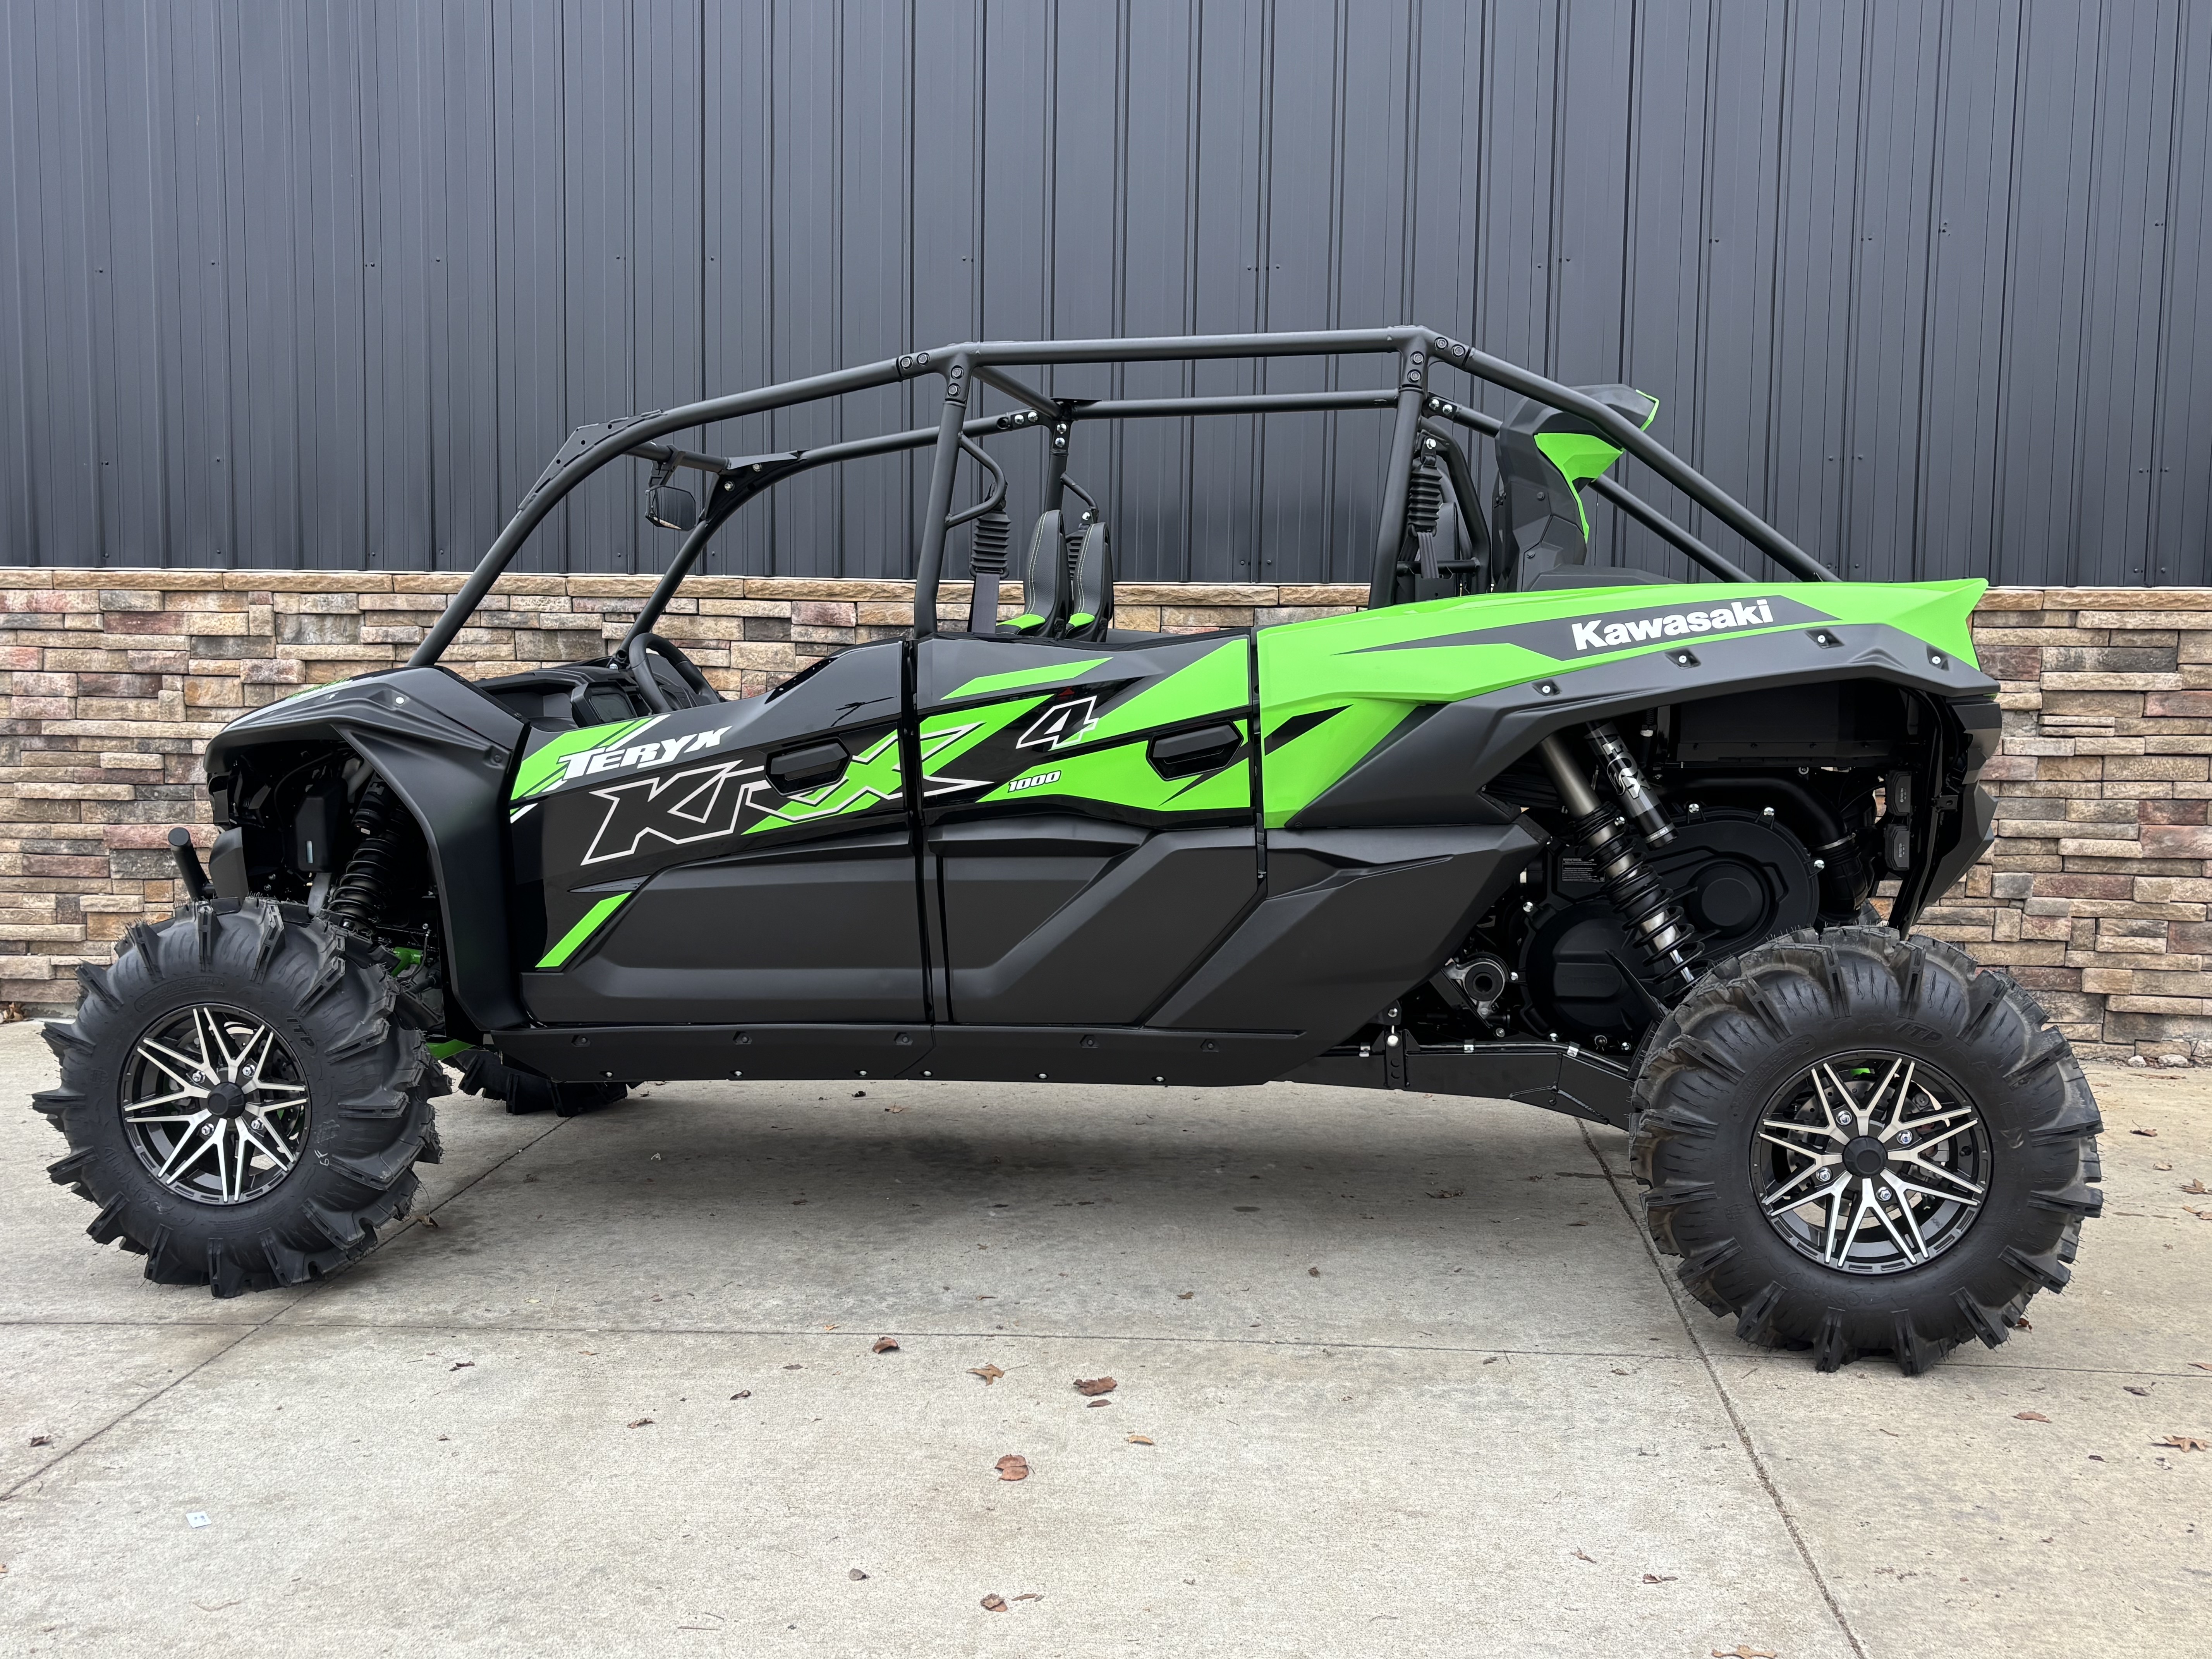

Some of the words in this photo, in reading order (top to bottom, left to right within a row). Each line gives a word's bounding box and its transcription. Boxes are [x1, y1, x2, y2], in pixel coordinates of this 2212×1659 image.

[1571, 599, 1774, 651] Kawasaki
[1015, 695, 1099, 751] 4
[558, 725, 733, 781] TERYX
[1602, 740, 1651, 799] FOX
[1008, 771, 1061, 792] 1000
[286, 1018, 315, 1047] ITP
[1894, 1022, 1943, 1042] ITP
